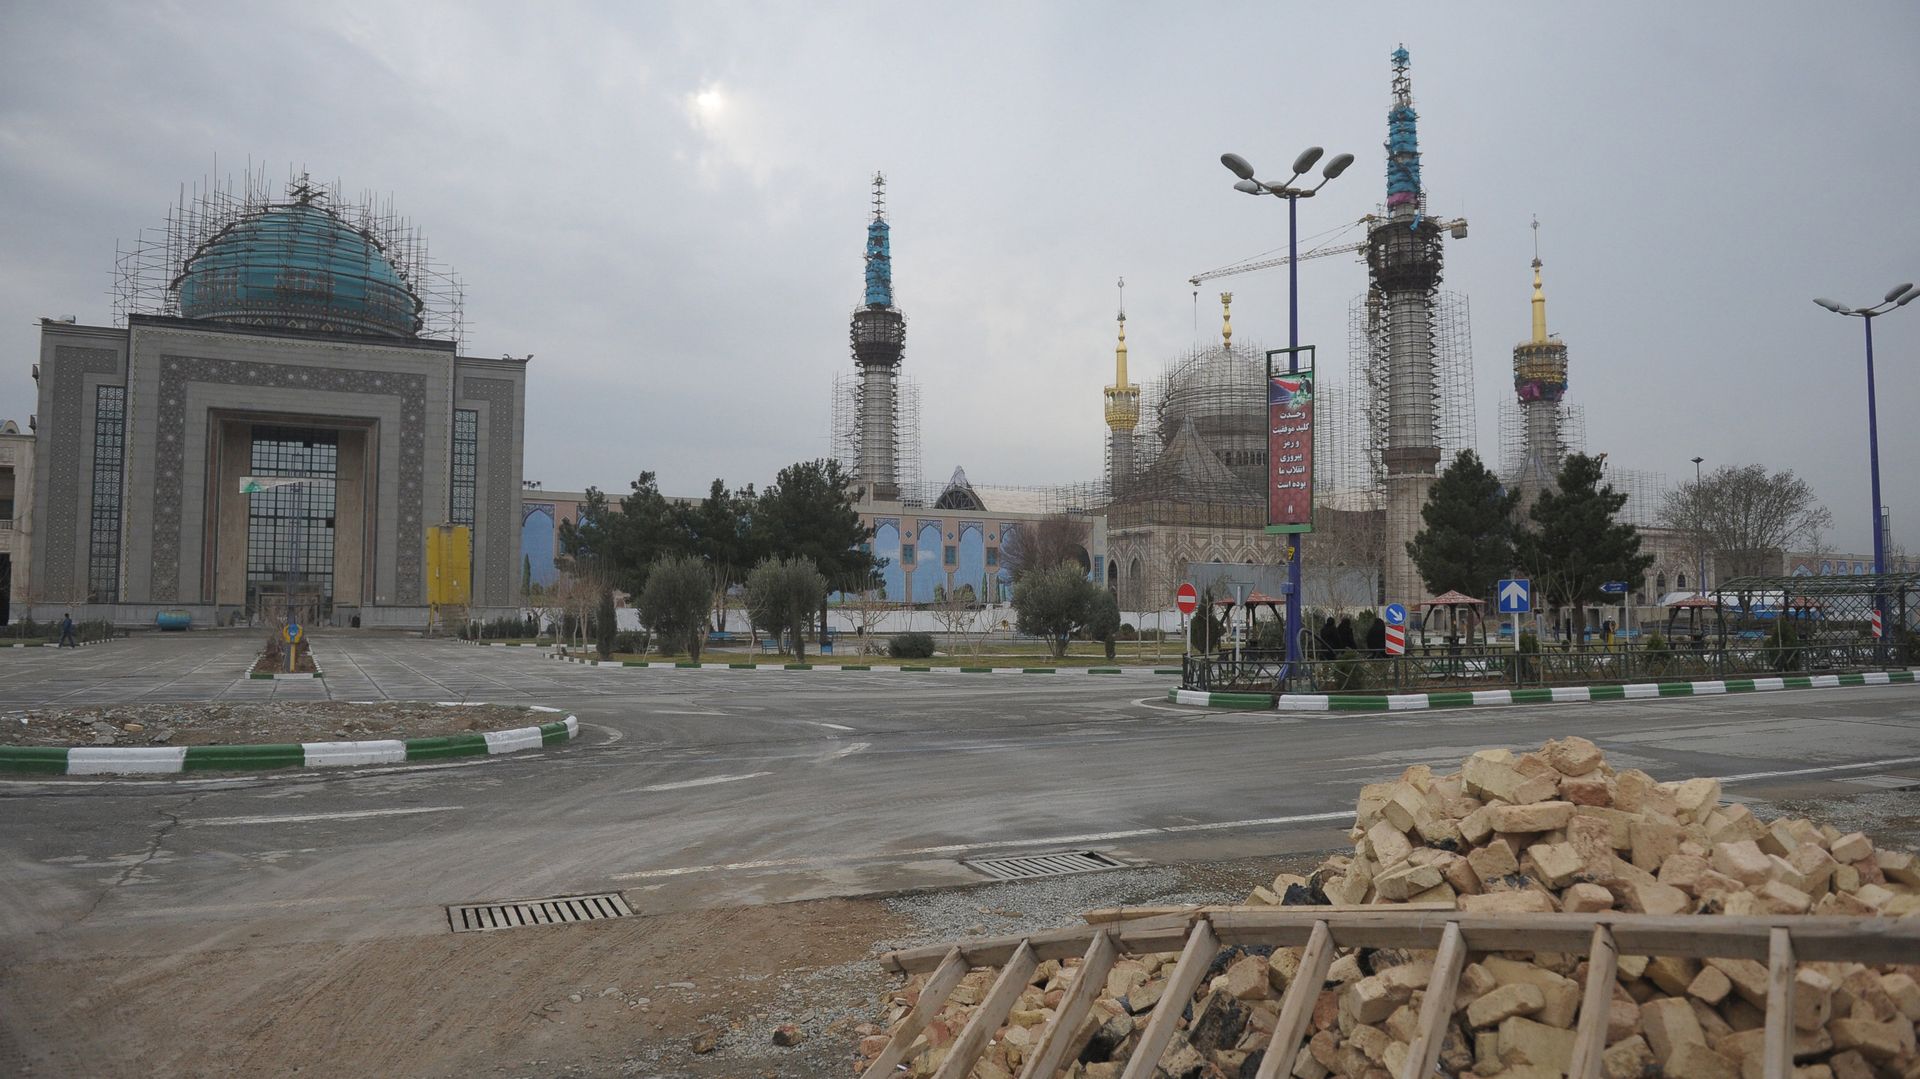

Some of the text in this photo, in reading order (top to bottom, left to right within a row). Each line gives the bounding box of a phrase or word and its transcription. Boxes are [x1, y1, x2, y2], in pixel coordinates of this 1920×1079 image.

[1280, 411, 1306, 419] وحدت
[1272, 422, 1310, 435] کلید موفقیت
[1283, 440, 1300, 449] و رمز
[1280, 453, 1303, 463] پیروزی
[1286, 465, 1305, 475] انقلاب
[1277, 480, 1306, 490] بوده است
